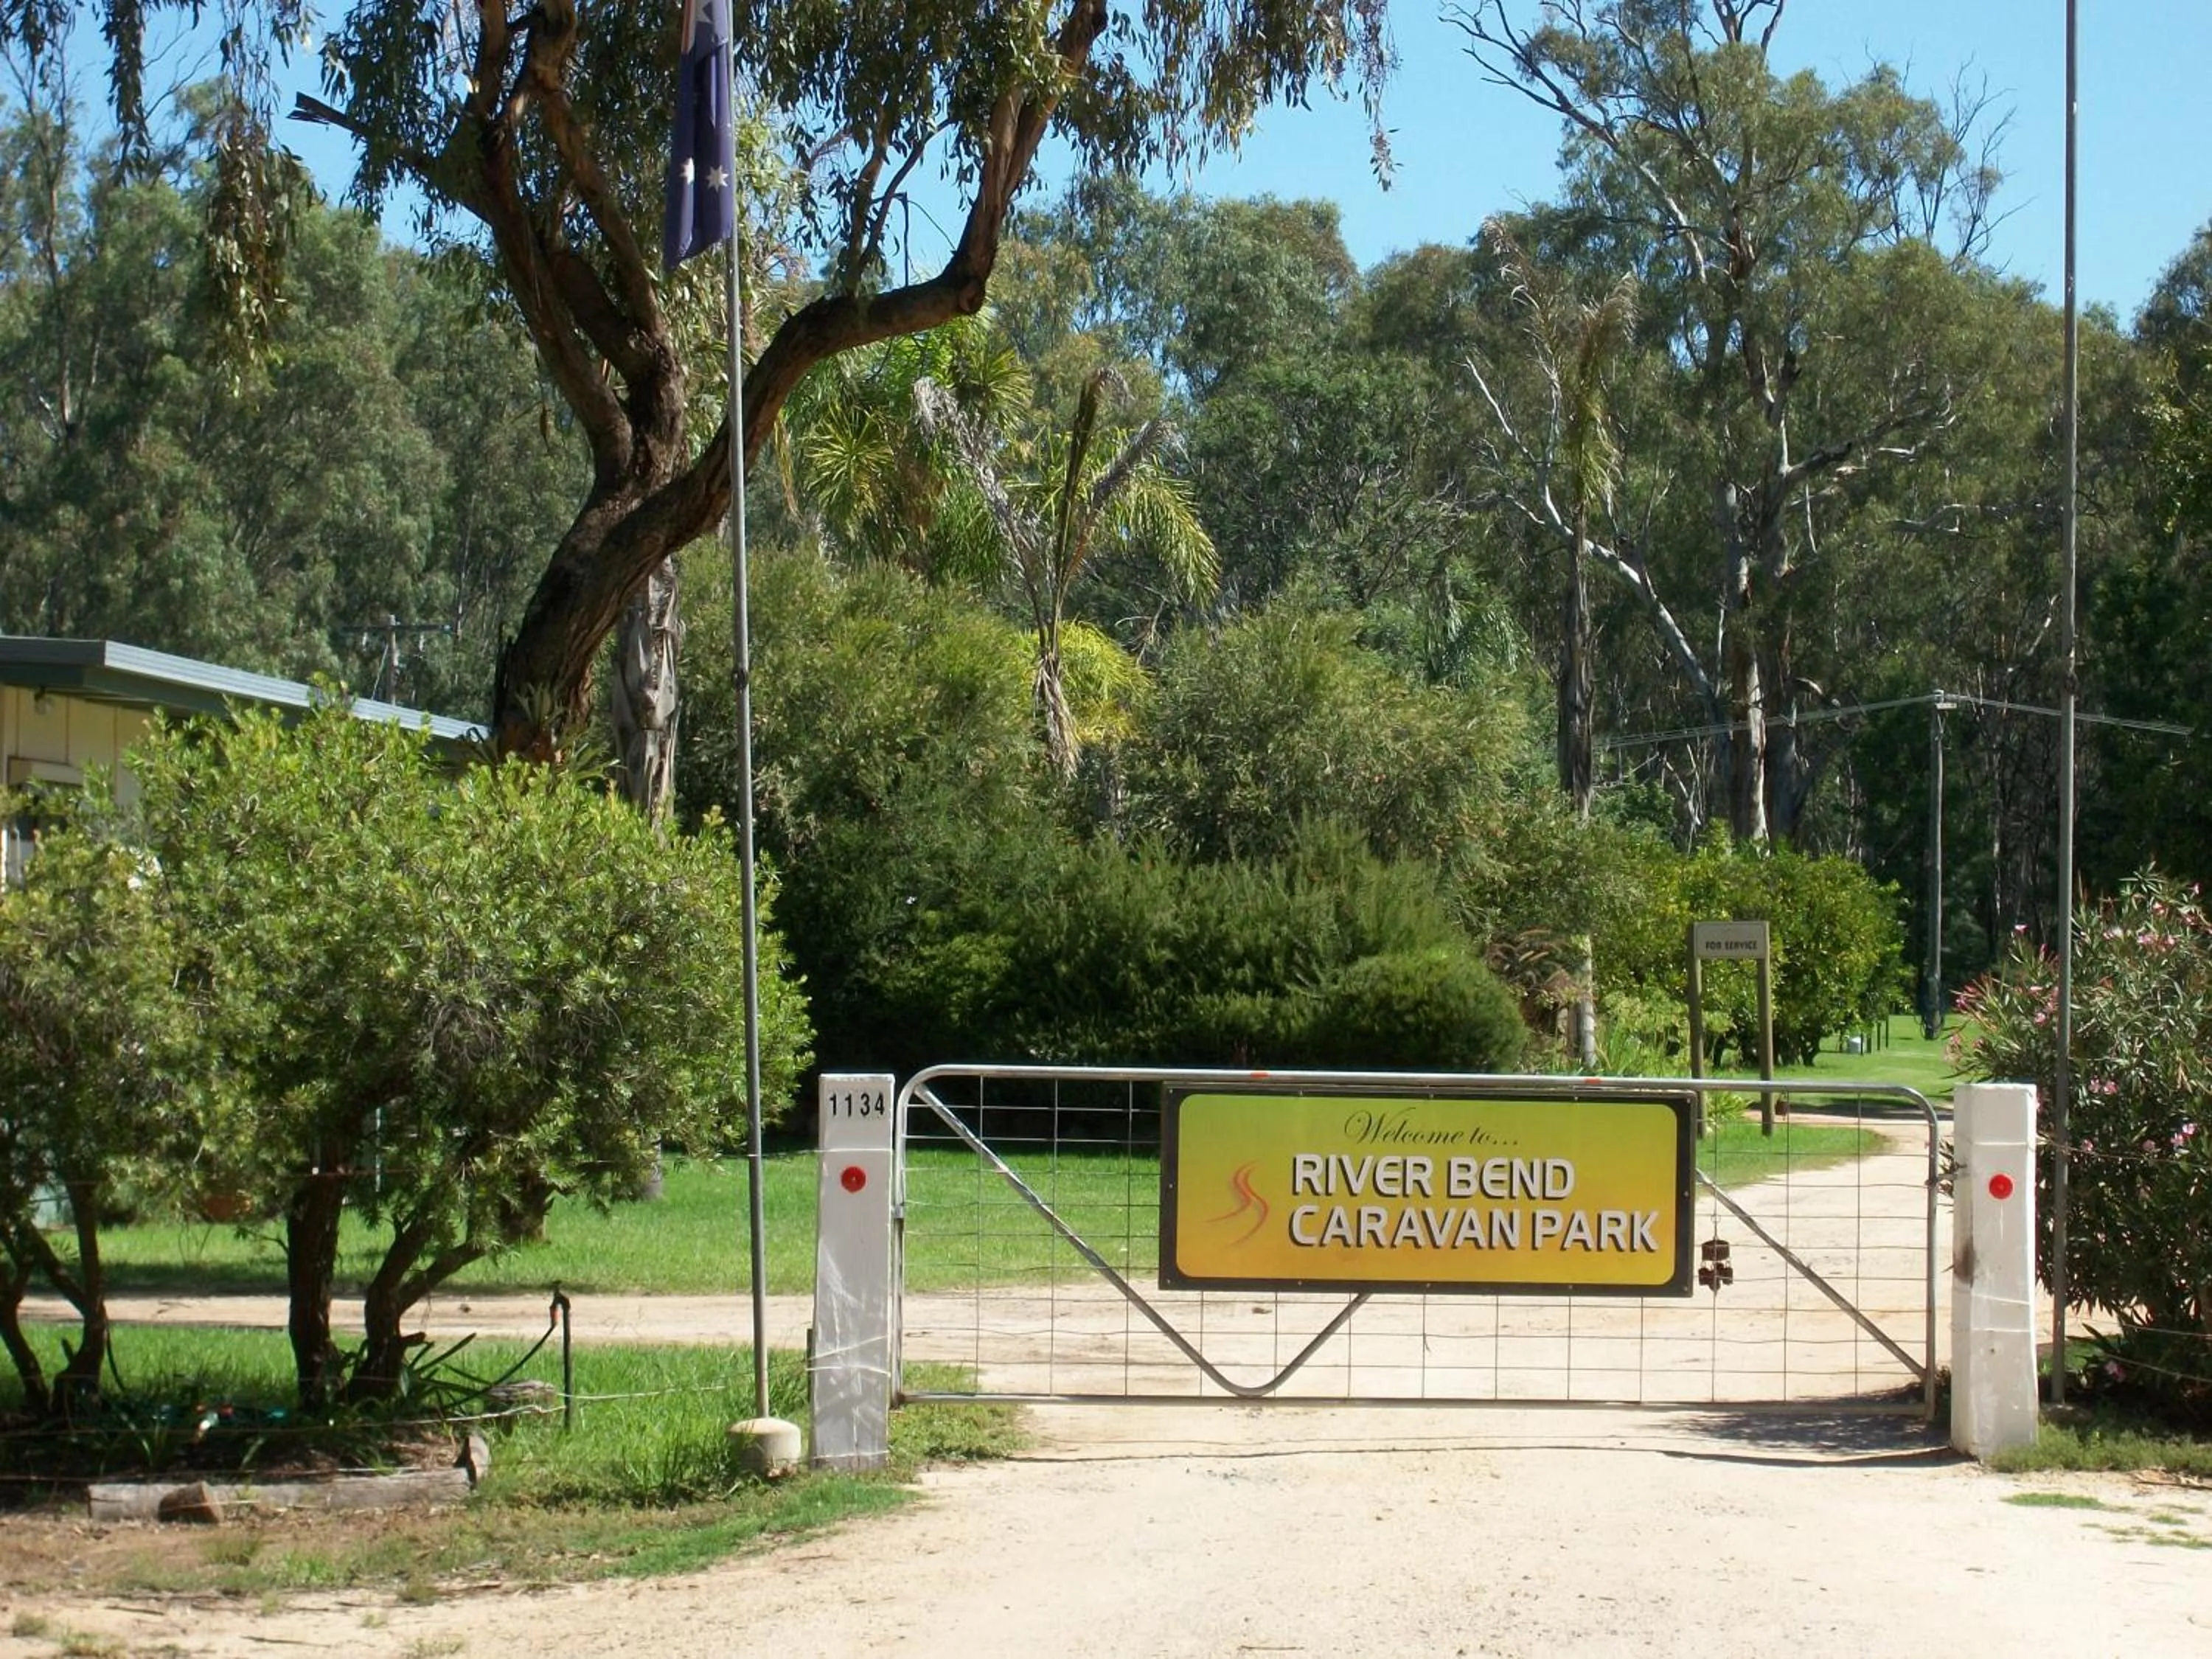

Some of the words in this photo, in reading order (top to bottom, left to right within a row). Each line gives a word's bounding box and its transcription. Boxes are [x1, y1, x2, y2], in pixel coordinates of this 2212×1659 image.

[1725, 939, 1758, 950] SERVICE
[830, 1093, 885, 1116] 1134
[1343, 1108, 1464, 1146] Welcome
[1469, 1125, 1520, 1147] to...
[1292, 1153, 1435, 1196] RIVER
[1448, 1156, 1576, 1200] BEND
[1289, 1205, 1520, 1249] CARAVAN
[1531, 1208, 1660, 1253] PARK
